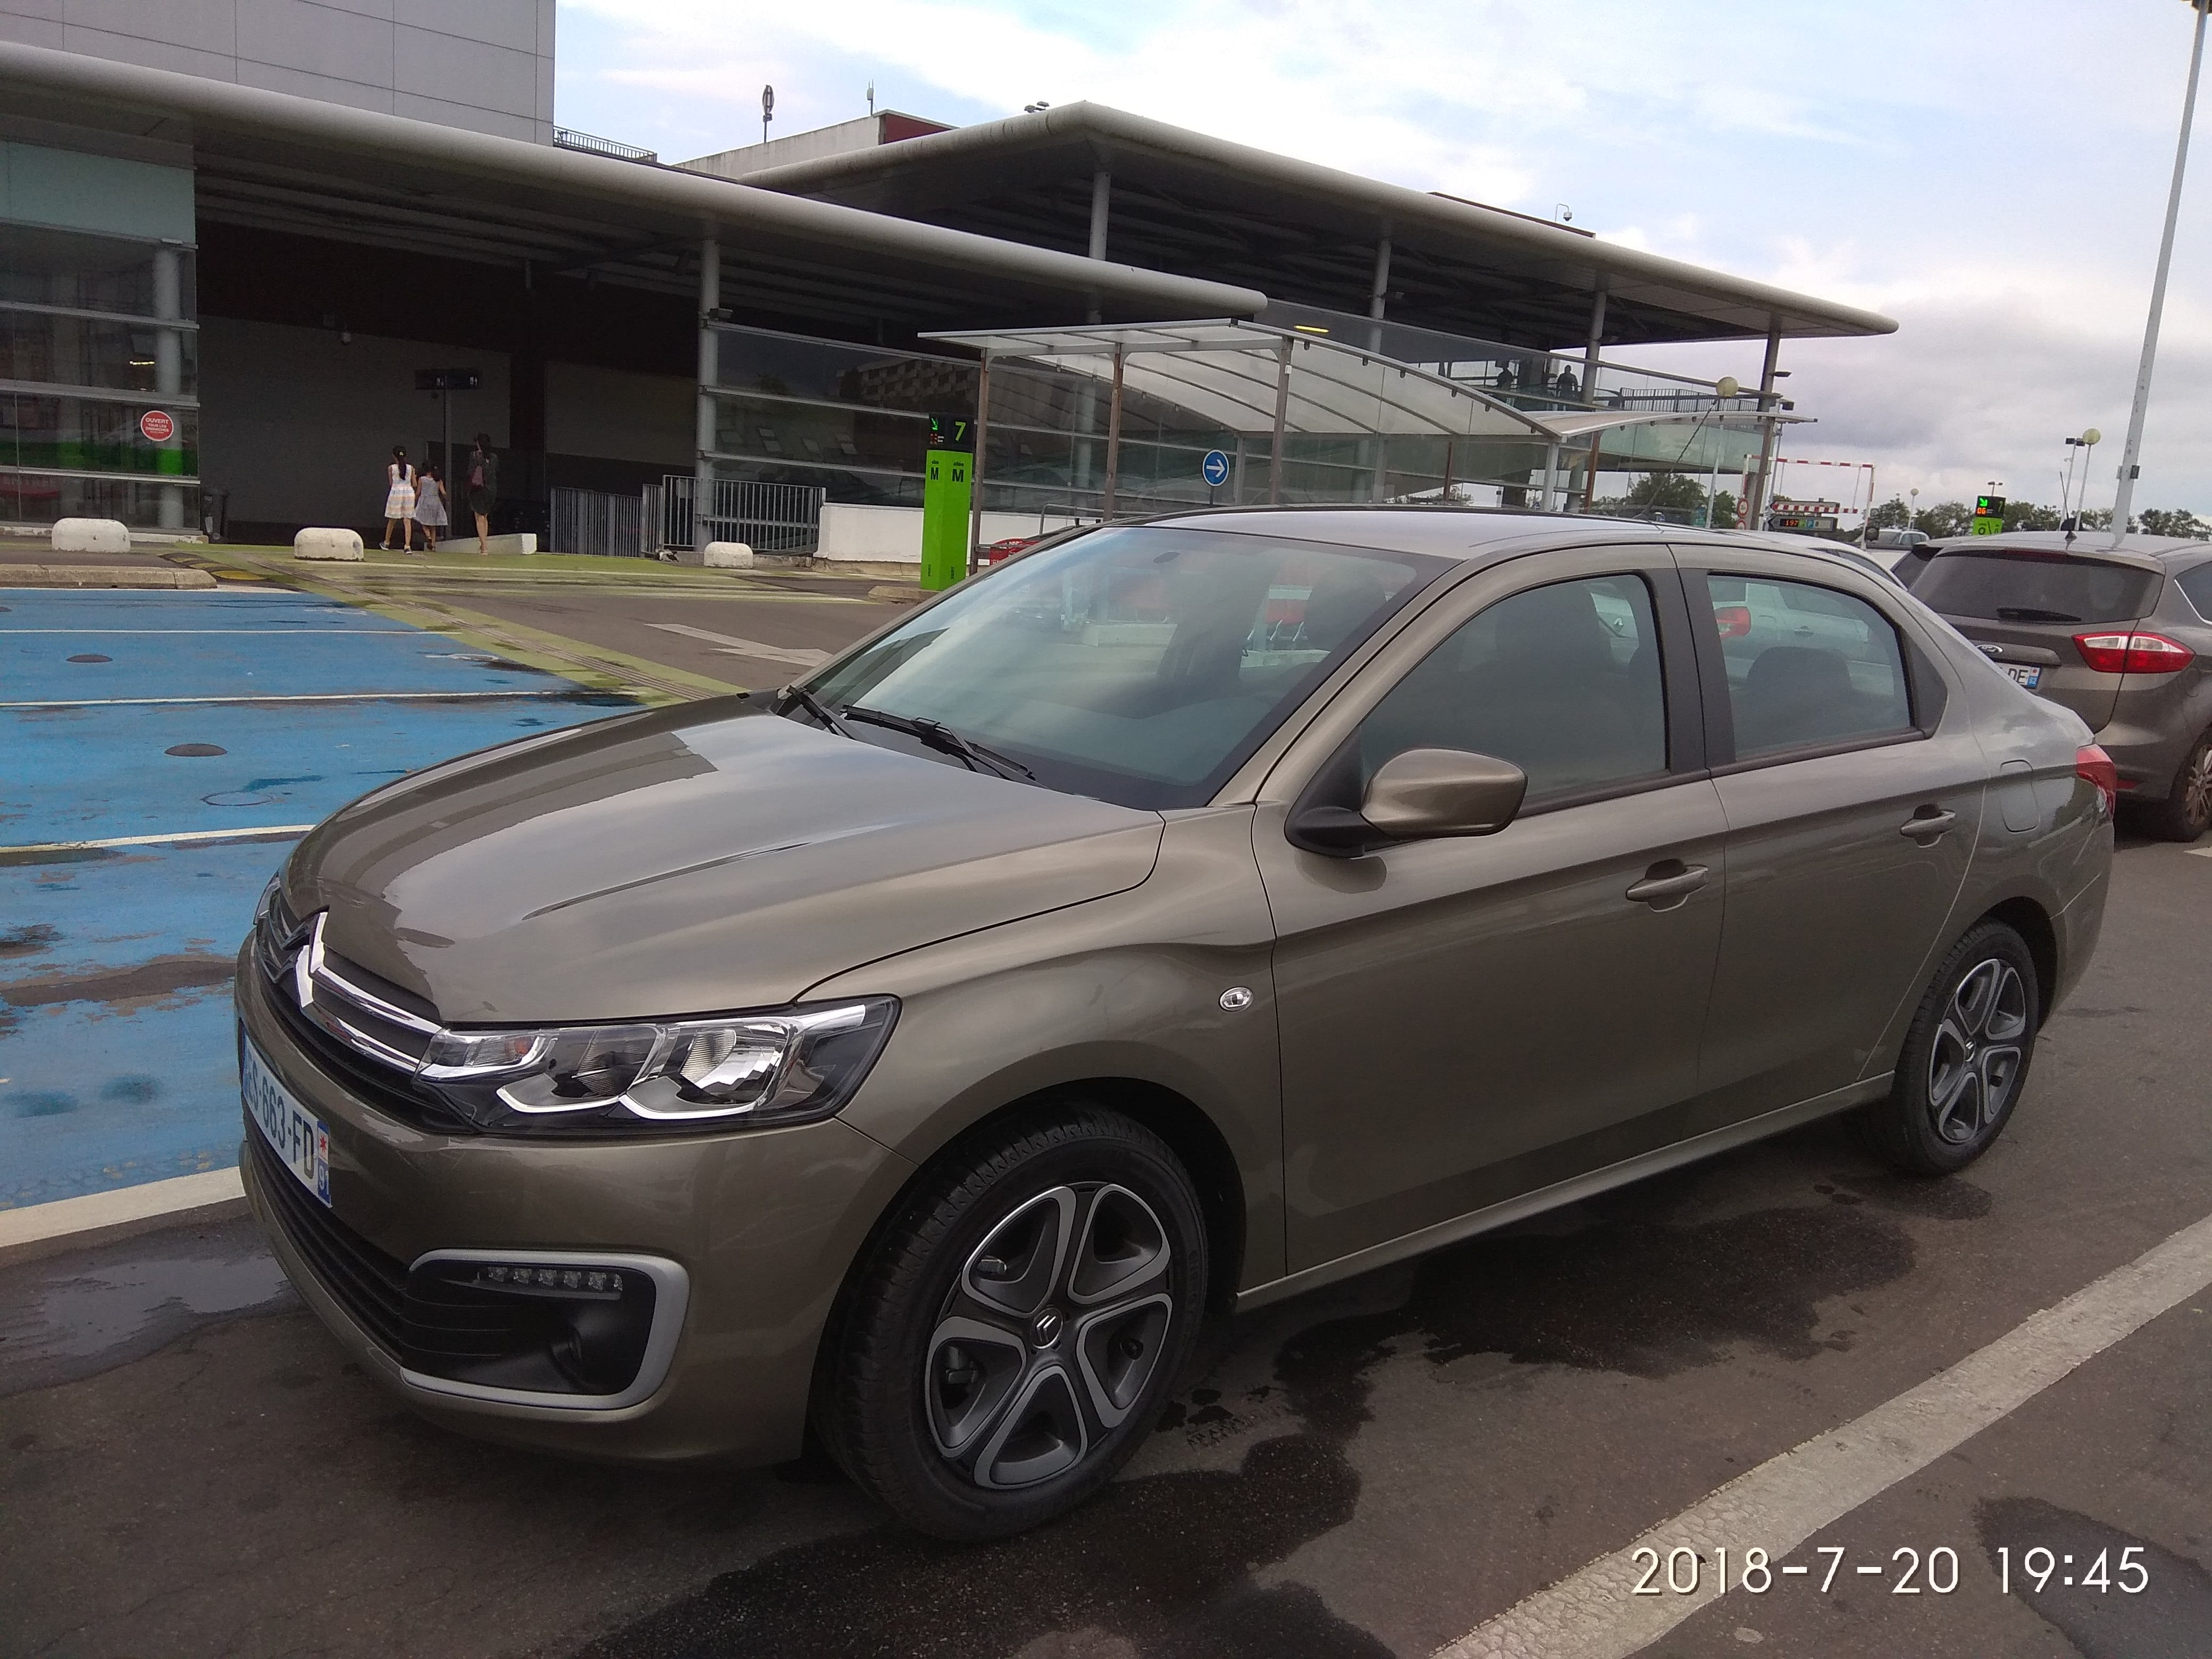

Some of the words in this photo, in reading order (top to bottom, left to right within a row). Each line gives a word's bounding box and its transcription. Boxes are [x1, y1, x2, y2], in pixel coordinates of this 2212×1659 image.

[955, 421, 966, 441] 7
[930, 467, 939, 481] M
[952, 468, 964, 483] M
